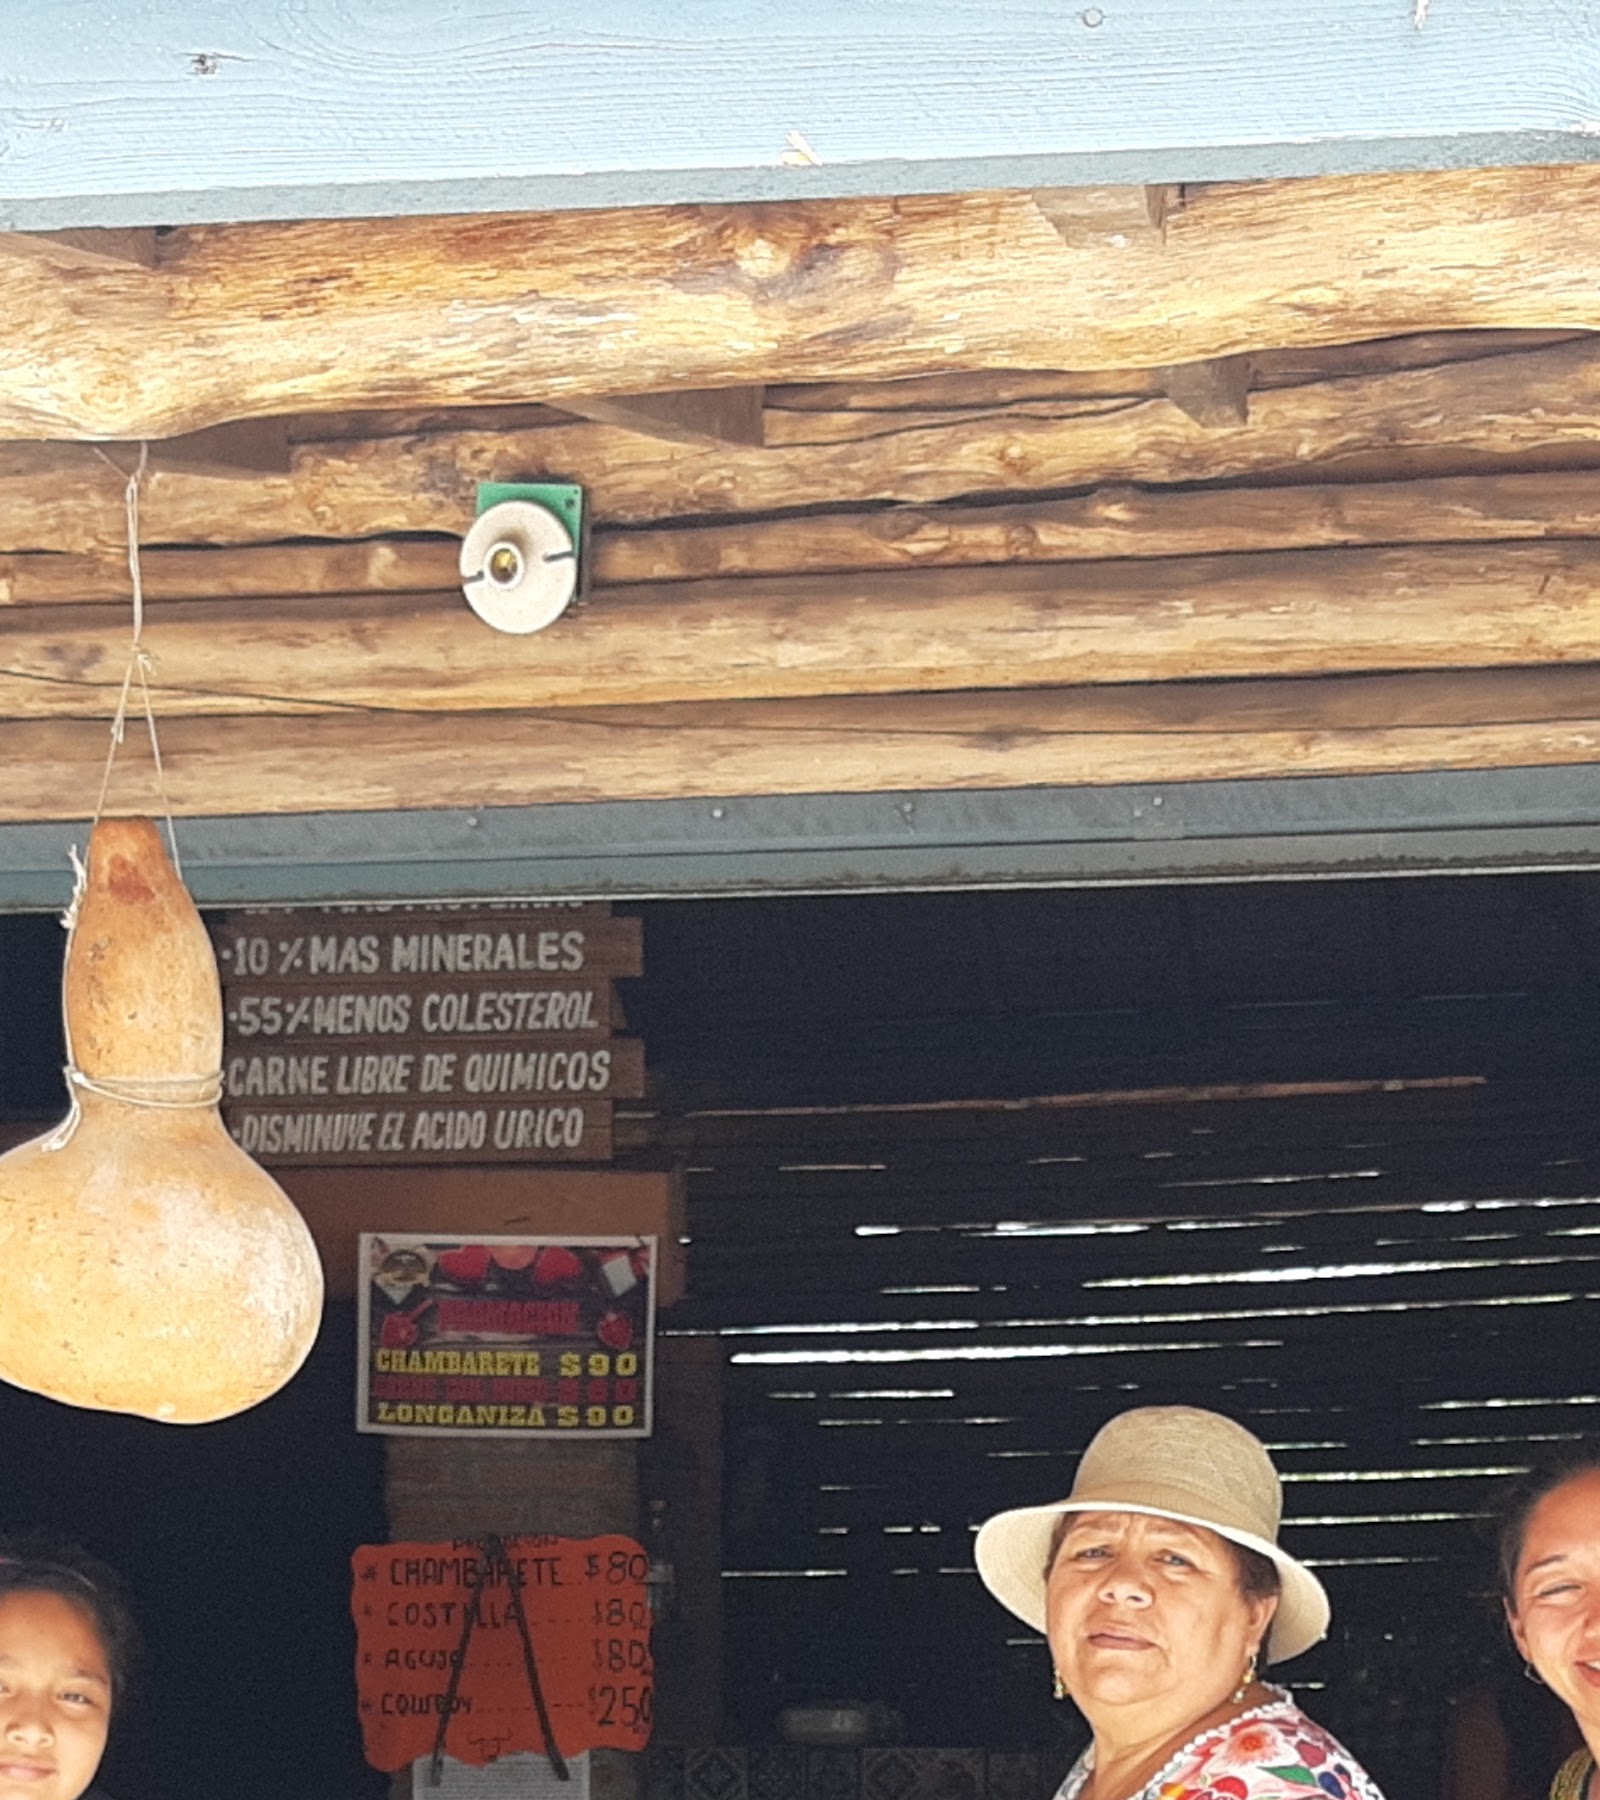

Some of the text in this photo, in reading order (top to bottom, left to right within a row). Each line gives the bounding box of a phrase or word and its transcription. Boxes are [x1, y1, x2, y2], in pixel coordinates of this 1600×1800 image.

[234, 937, 269, 976] 10
[311, 936, 380, 973] MAS
[392, 931, 585, 973] MINERALES
[313, 994, 412, 1034] MENOS
[422, 991, 598, 1031] COLESTEROL
[228, 1050, 611, 1096] CARNE LIBRE DE QUIMICOS
[241, 1108, 584, 1154] DISMINUYE EL ACIDO URICO
[376, 1350, 540, 1376] CHAMBARETE
[377, 1402, 546, 1426] LONGANIZA
